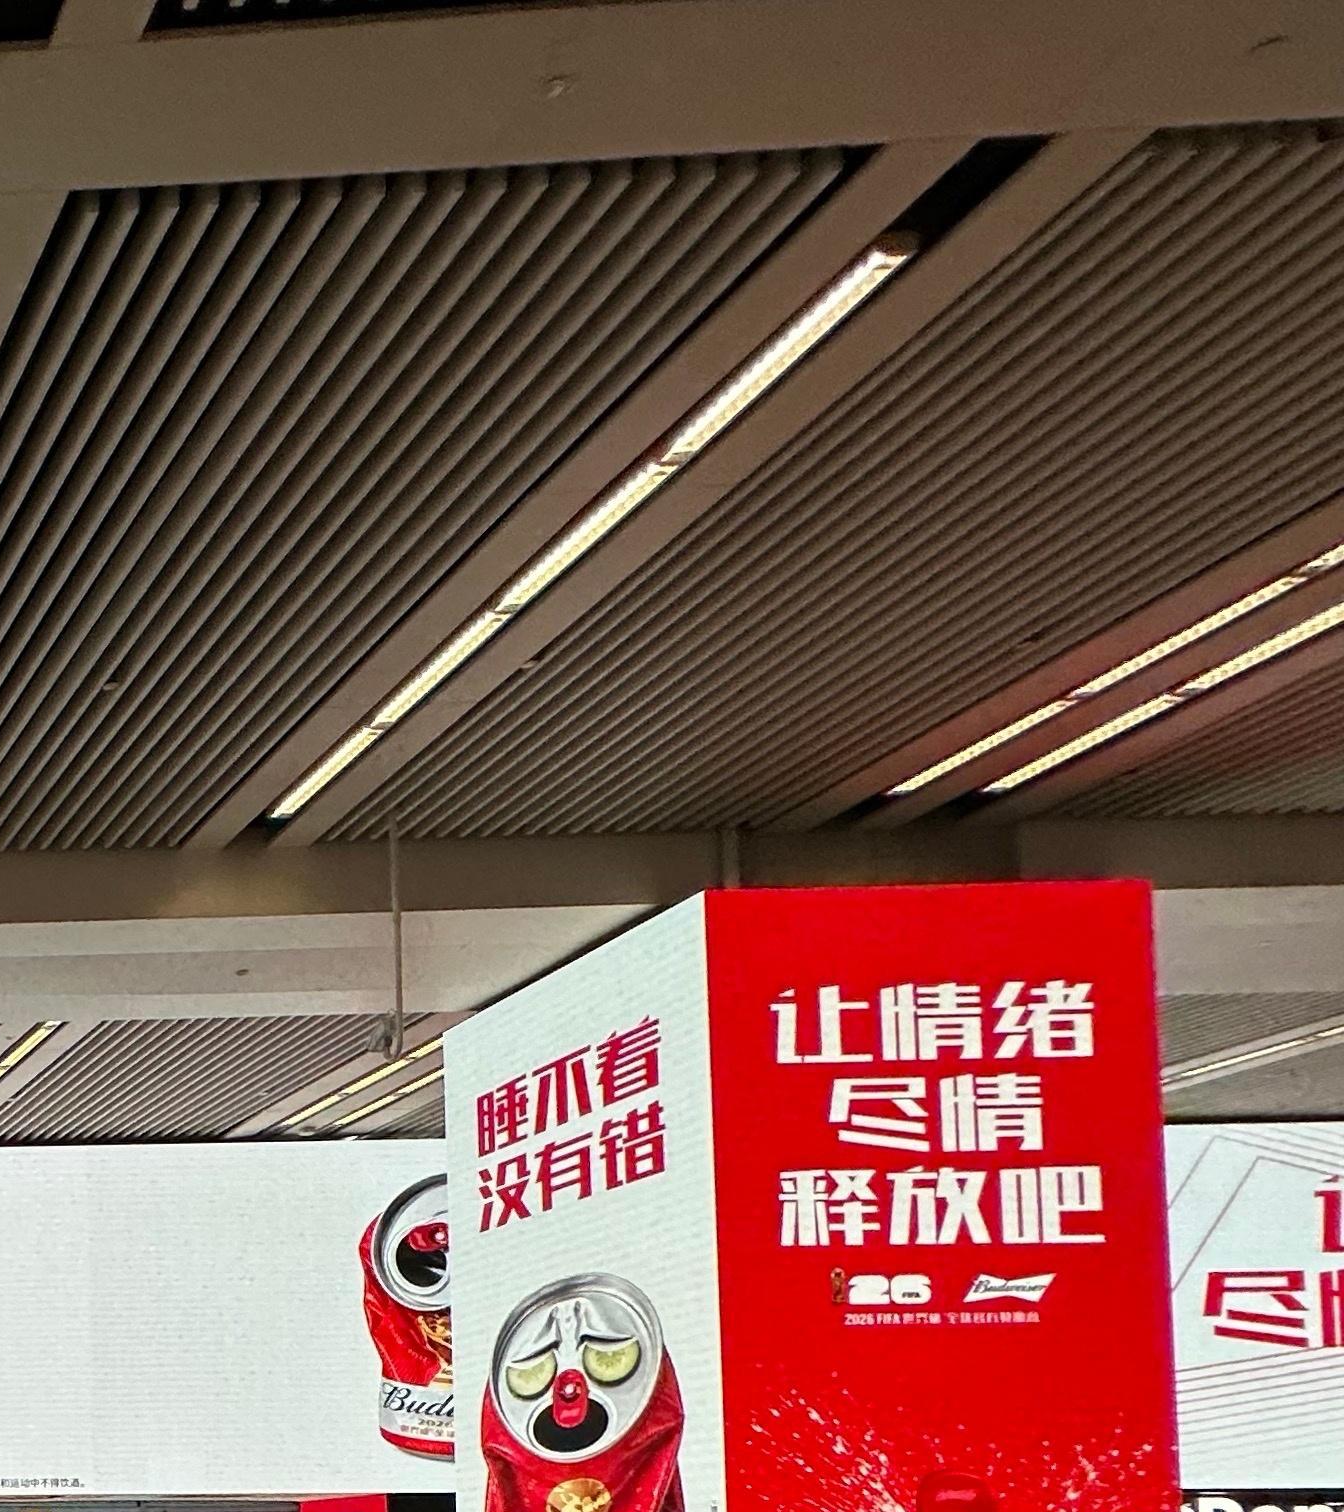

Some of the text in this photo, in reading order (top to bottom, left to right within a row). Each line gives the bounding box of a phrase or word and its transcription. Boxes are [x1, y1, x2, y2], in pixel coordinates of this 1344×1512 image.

[771, 980, 1094, 1064] 让情绪
[477, 1014, 661, 1158] 睡不着
[829, 1074, 1043, 1152] 尽情
[478, 1100, 666, 1233] 没有错
[779, 1165, 1105, 1247] 释放吧
[974, 1280, 1047, 1294] Budweiser
[1203, 1269, 1344, 1348] 尽
[382, 1382, 454, 1417] Bud
